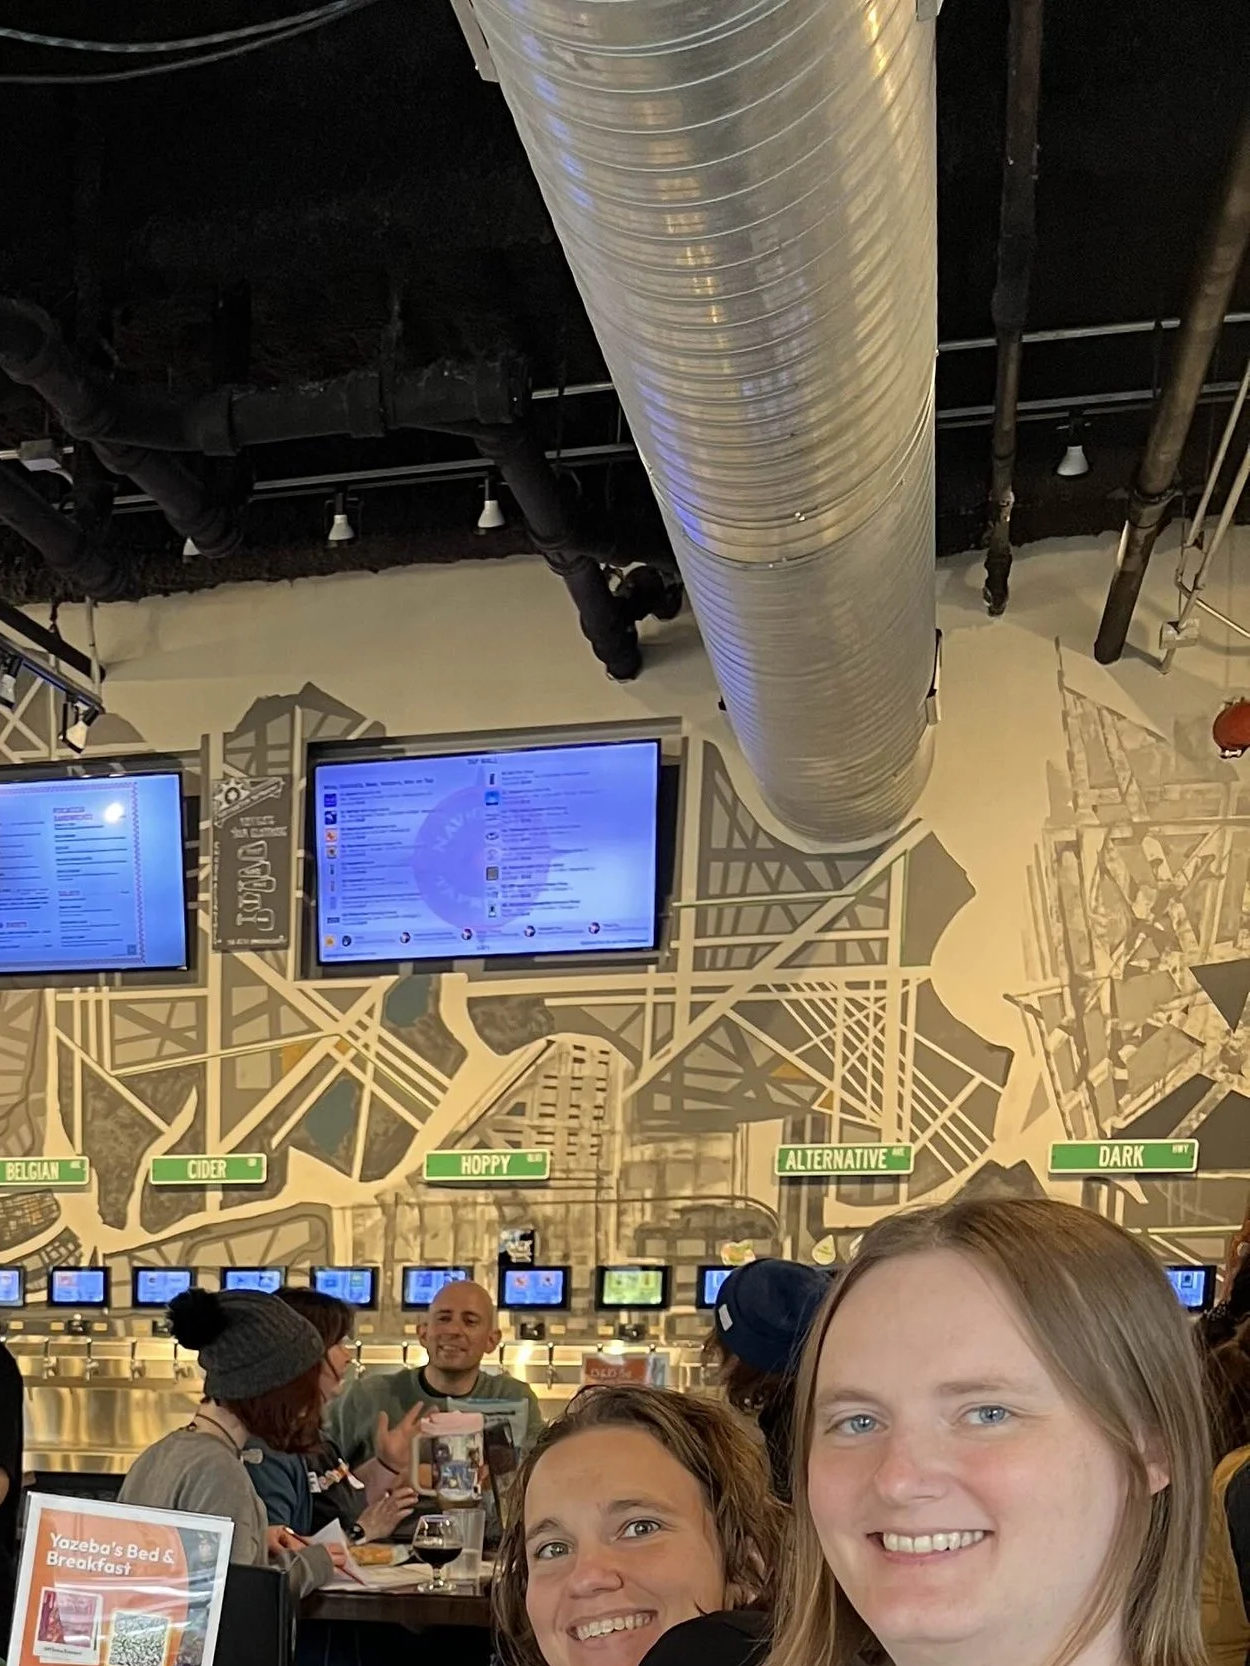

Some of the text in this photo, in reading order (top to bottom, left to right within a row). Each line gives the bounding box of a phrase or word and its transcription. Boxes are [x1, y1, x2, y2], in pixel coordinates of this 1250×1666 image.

[460, 1155, 511, 1175] HOPPY
[785, 1148, 887, 1170] ALTERNATIVE
[1099, 1144, 1190, 1168] DARK HWY
[5, 1162, 59, 1181] BELGIAN
[187, 1158, 227, 1179] CIDER
[50, 1533, 175, 1564] Yazeba's Bed &
[46, 1551, 132, 1575] Breakfast
